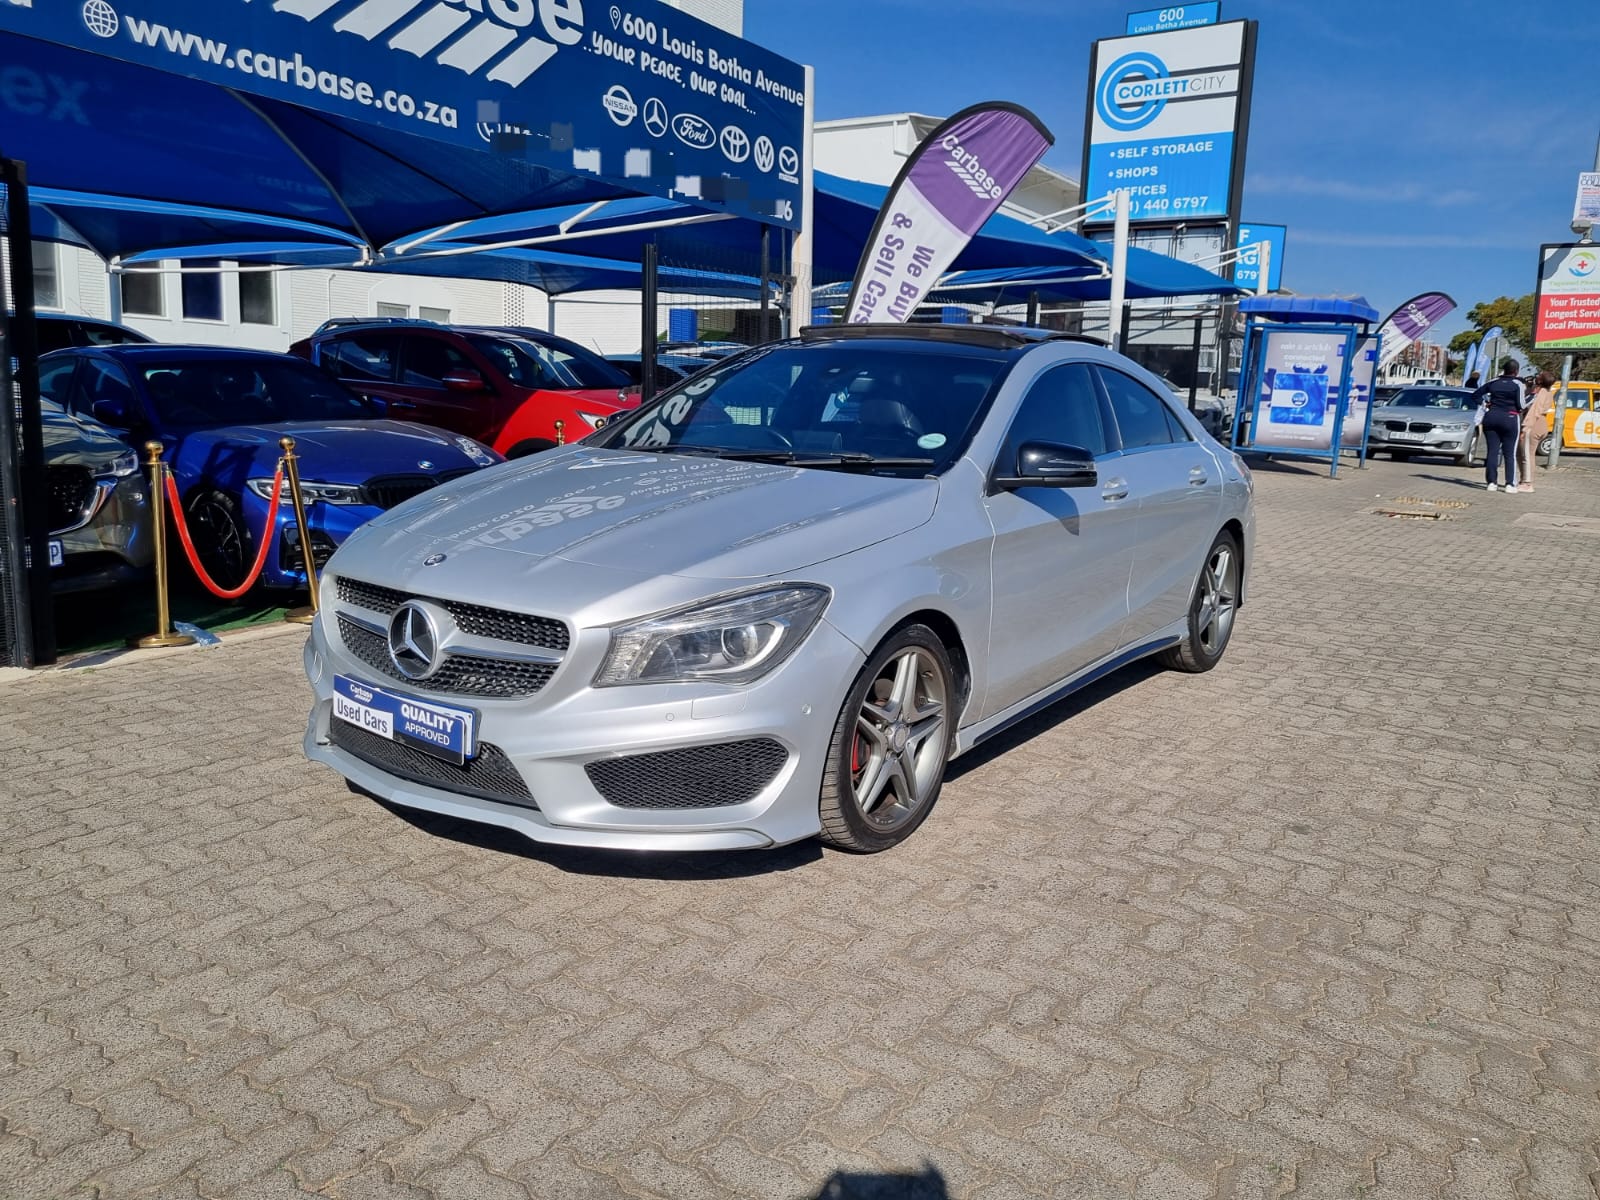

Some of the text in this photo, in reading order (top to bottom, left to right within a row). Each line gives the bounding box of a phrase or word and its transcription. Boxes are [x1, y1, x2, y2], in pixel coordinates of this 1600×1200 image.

[1134, 7, 1208, 33] 600 Louis Botha Avenue
[125, 15, 458, 129] www.carbase.co.za
[623, 12, 805, 107] 600 Louis Botha Avenue
[640, 50, 686, 88] PEACE,
[689, 71, 717, 96] OUR
[604, 97, 637, 114] NISSAN
[680, 117, 709, 144] Ford
[1117, 141, 1214, 159] SELF STORAGE
[941, 135, 1003, 200] Carbase
[1115, 166, 1159, 179] SHOPS
[1143, 198, 1170, 210] 440
[1173, 196, 1209, 209] 6797
[853, 212, 913, 324] & Sell Cars
[1237, 270, 1260, 280] 679
[887, 245, 935, 322] We Buy
[1545, 310, 1577, 319] Longest
[1550, 297, 1600, 307] Your Trusted
[1544, 321, 1566, 330] Local
[337, 697, 388, 733] Used Cars
[401, 703, 454, 732] QUALITY
[405, 721, 450, 746] APPROVED
